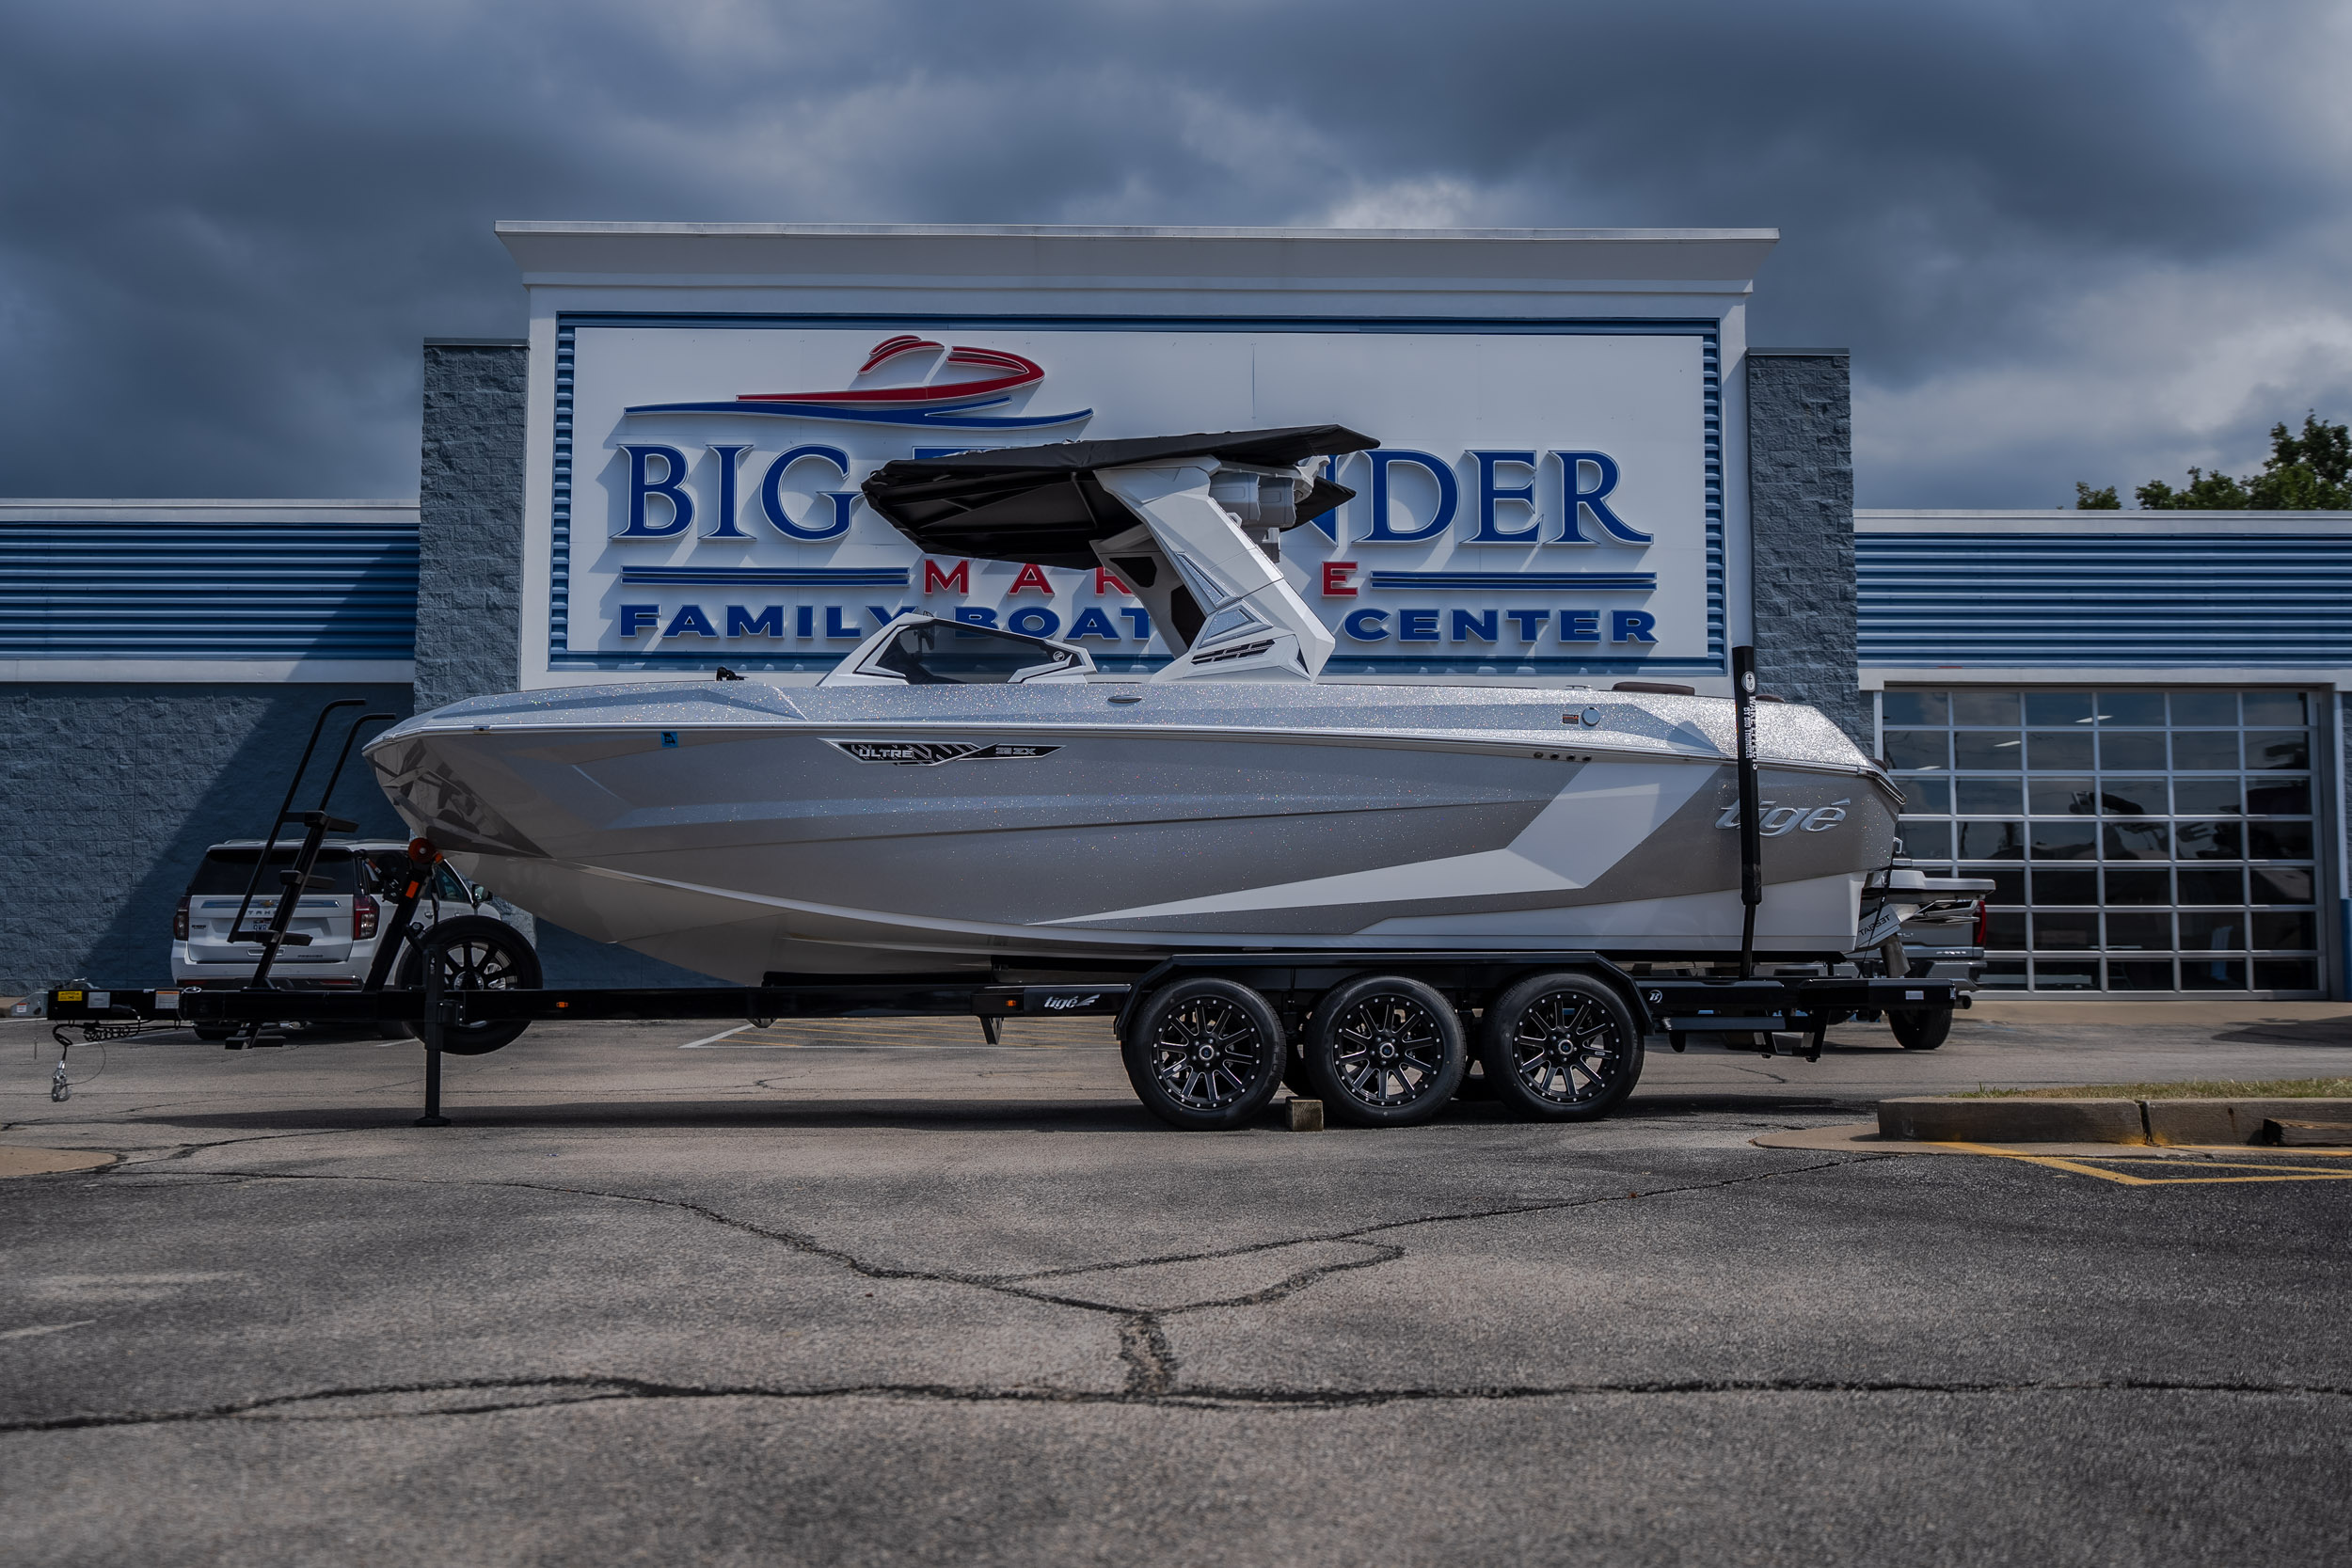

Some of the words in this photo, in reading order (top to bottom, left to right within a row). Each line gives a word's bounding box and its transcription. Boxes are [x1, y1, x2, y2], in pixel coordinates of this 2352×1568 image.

[612, 443, 864, 542] BIG
[619, 605, 918, 640] FAMILY
[1343, 609, 1659, 643] CENTER
[1044, 995, 1078, 1010] tigé
